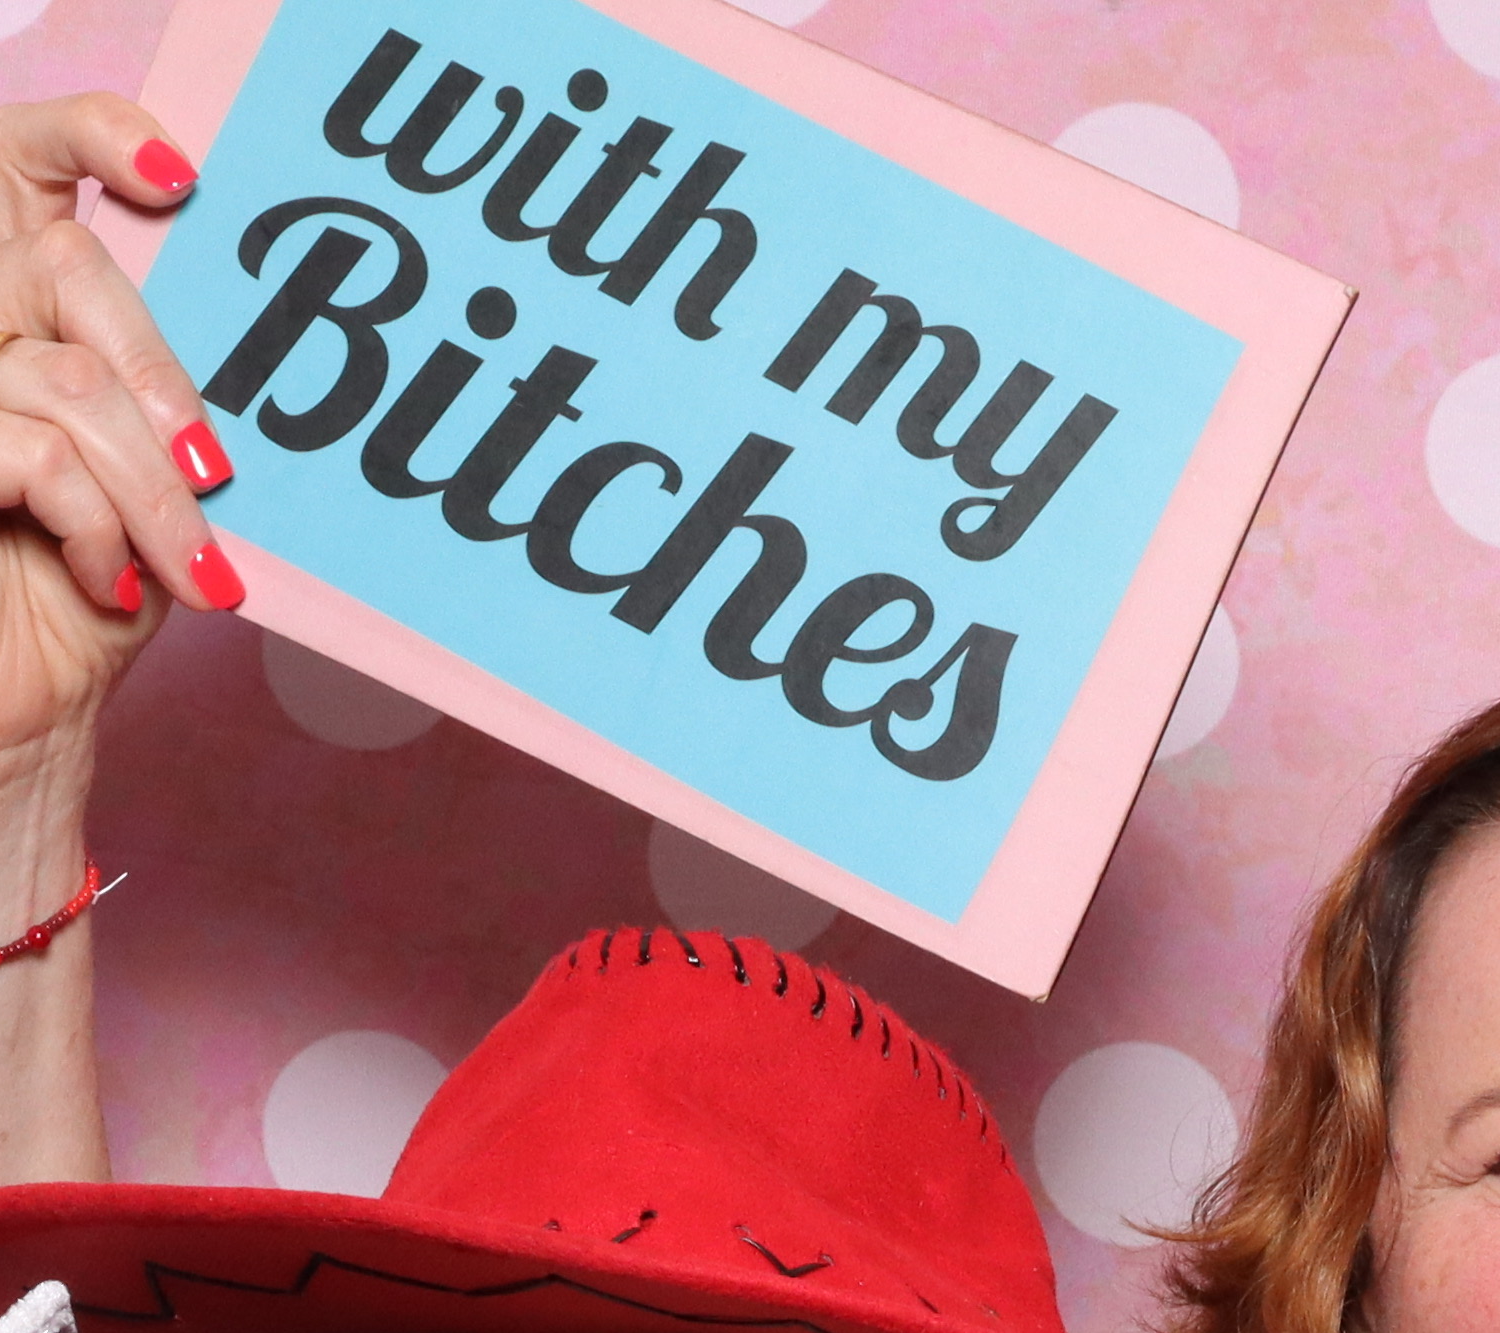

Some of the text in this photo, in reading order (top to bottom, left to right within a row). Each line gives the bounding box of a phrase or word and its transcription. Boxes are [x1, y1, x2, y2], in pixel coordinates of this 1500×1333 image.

[200, 195, 1019, 782] Bitches
[322, 27, 1120, 562] with my
